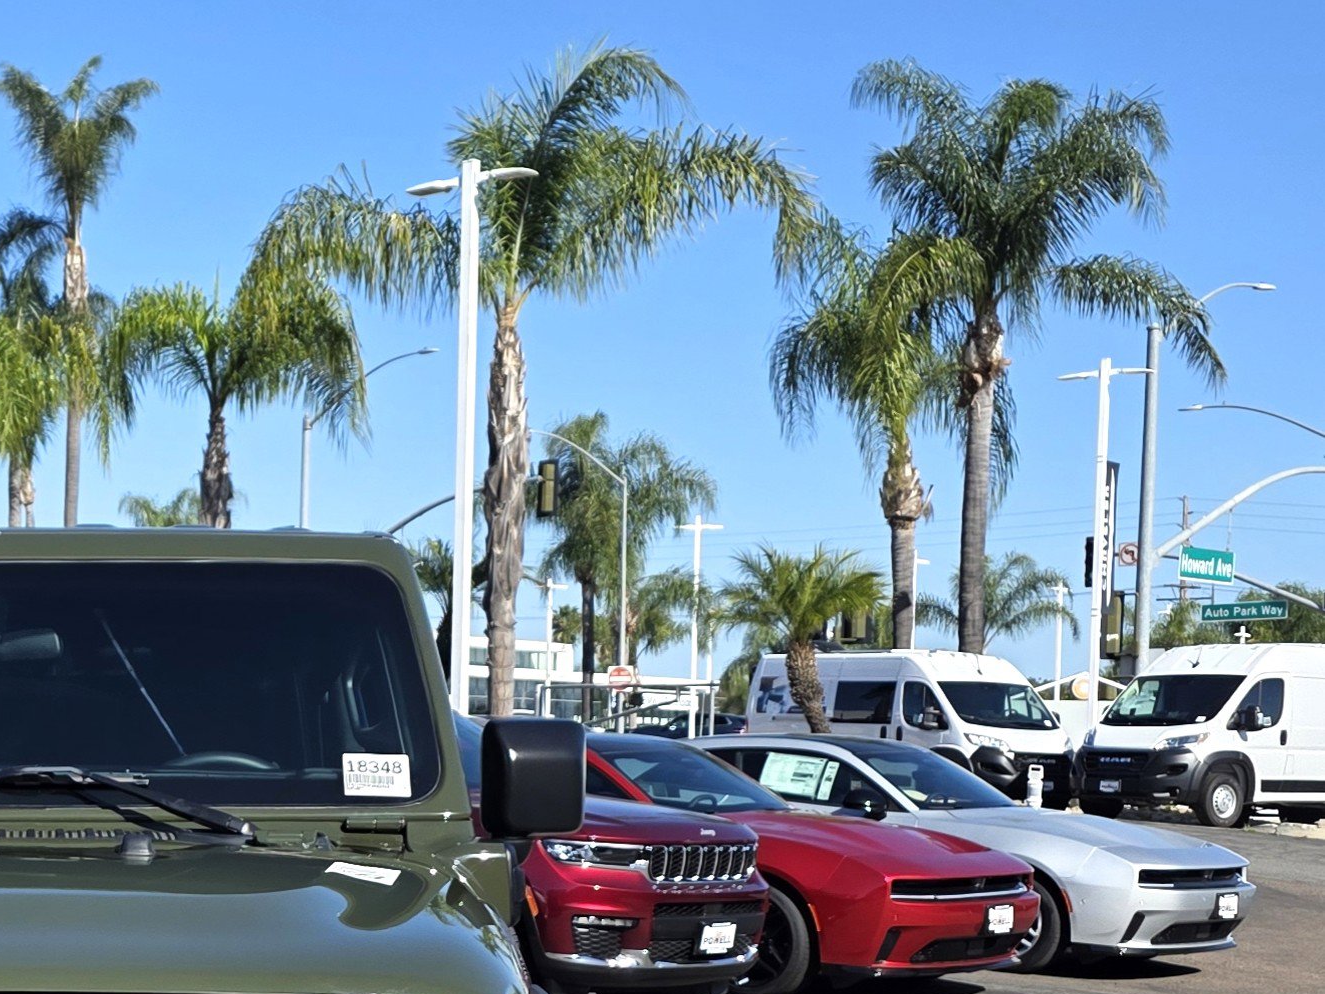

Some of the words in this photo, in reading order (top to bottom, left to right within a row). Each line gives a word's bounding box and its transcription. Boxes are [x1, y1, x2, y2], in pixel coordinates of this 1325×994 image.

[1181, 553, 1215, 576] Howard
[1216, 558, 1233, 578] Ave
[1204, 607, 1229, 618] Auto
[1233, 606, 1258, 617] Park
[1261, 604, 1284, 616] Way
[347, 760, 402, 774] 18348
